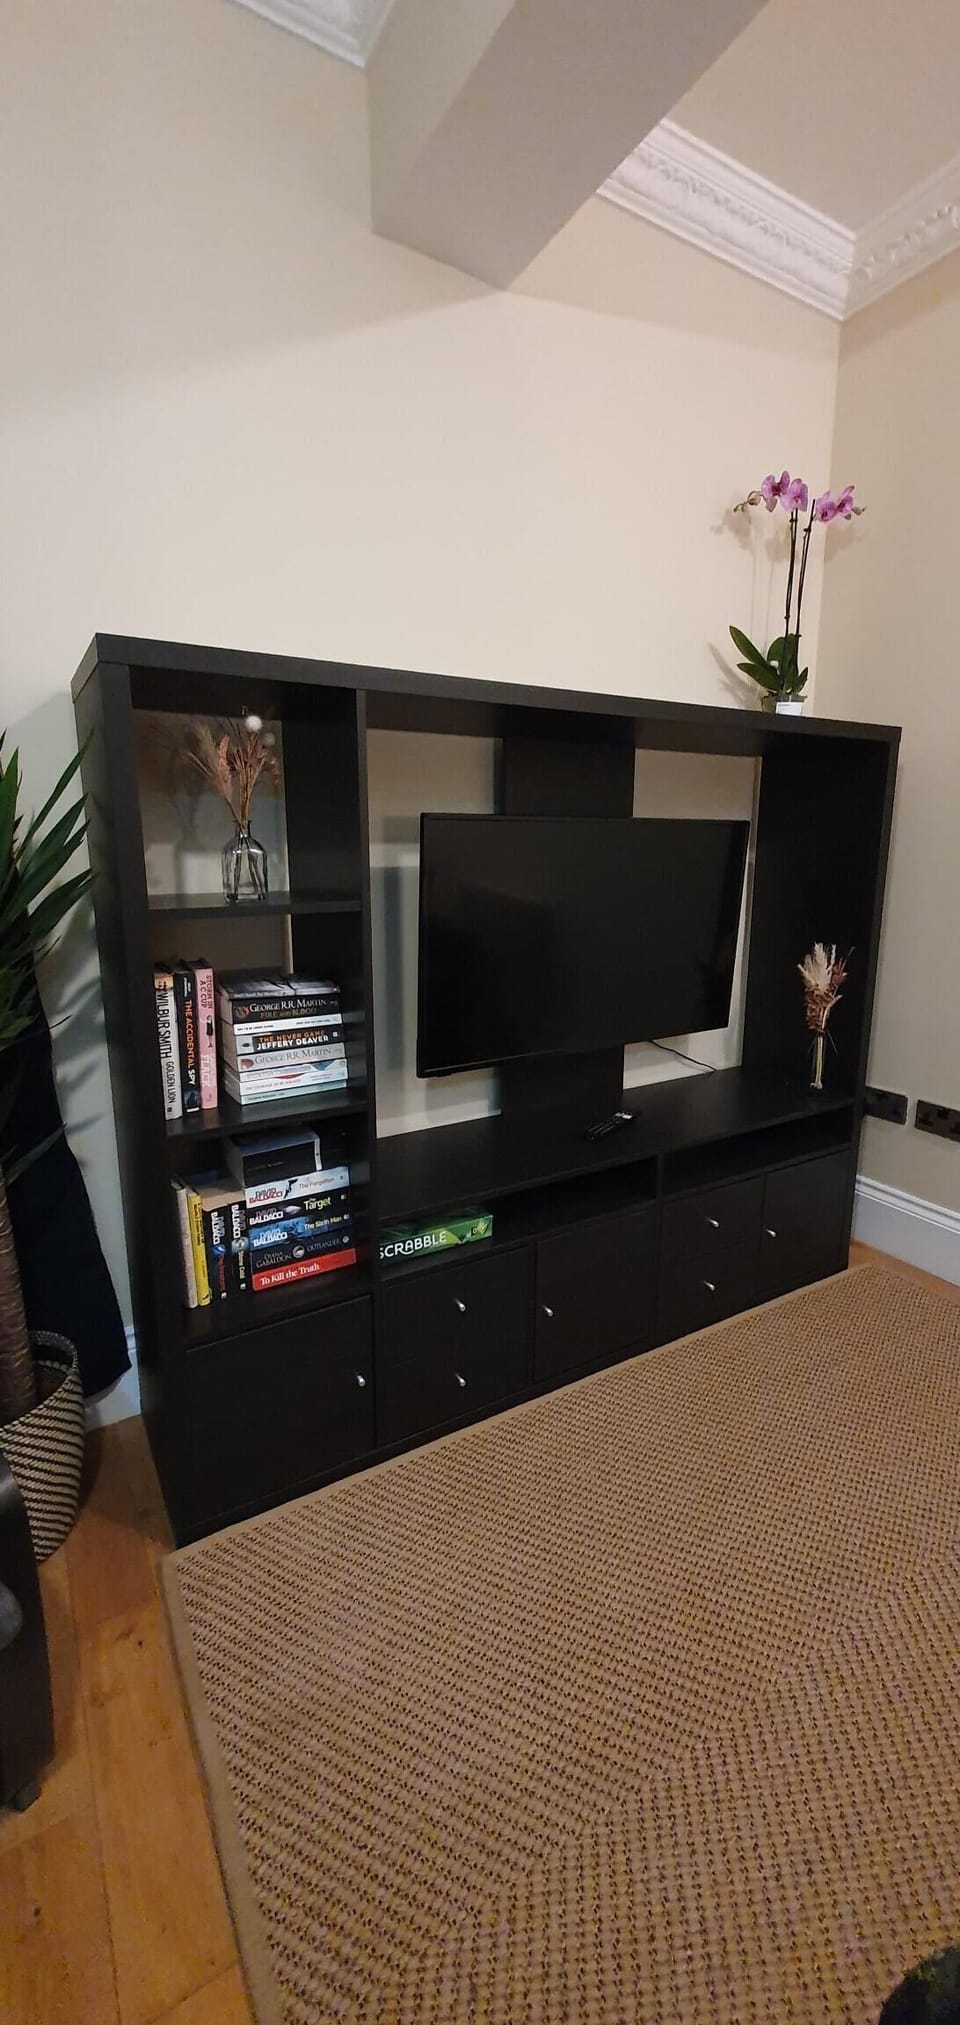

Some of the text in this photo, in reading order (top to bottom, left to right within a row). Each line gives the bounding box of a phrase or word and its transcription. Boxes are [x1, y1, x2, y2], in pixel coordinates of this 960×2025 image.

[184, 1000, 193, 1017] THE
[200, 994, 208, 1008] CUP
[250, 1002, 280, 1013] GEORGE
[296, 998, 327, 1008] MARTIN
[156, 992, 170, 1029] WILBUR
[158, 1030, 172, 1058] SMITH
[186, 1018, 195, 1068] ACCIDENTAL
[256, 1035, 328, 1050] JEFFERY DEAVER
[276, 1032, 302, 1041] NEVER
[254, 1054, 285, 1065] GEORGE
[302, 1047, 332, 1057] MARTIN
[166, 1061, 175, 1087] GOLDEN
[188, 1069, 196, 1085] SPY
[168, 1088, 176, 1104] LION
[248, 1190, 284, 1204] BALDACCI
[304, 1196, 332, 1212] Target
[231, 1204, 241, 1239] BALDACCI
[249, 1211, 284, 1225] BALDACCI
[330, 1216, 342, 1224] Man
[210, 1211, 220, 1246] BALDACCI
[253, 1231, 288, 1247] BALDACCI
[306, 1238, 340, 1252] OUTLANDER
[256, 1254, 292, 1268] GABALDON
[238, 1266, 246, 1279] Cold
[260, 1262, 320, 1286] To Kill the Truth
